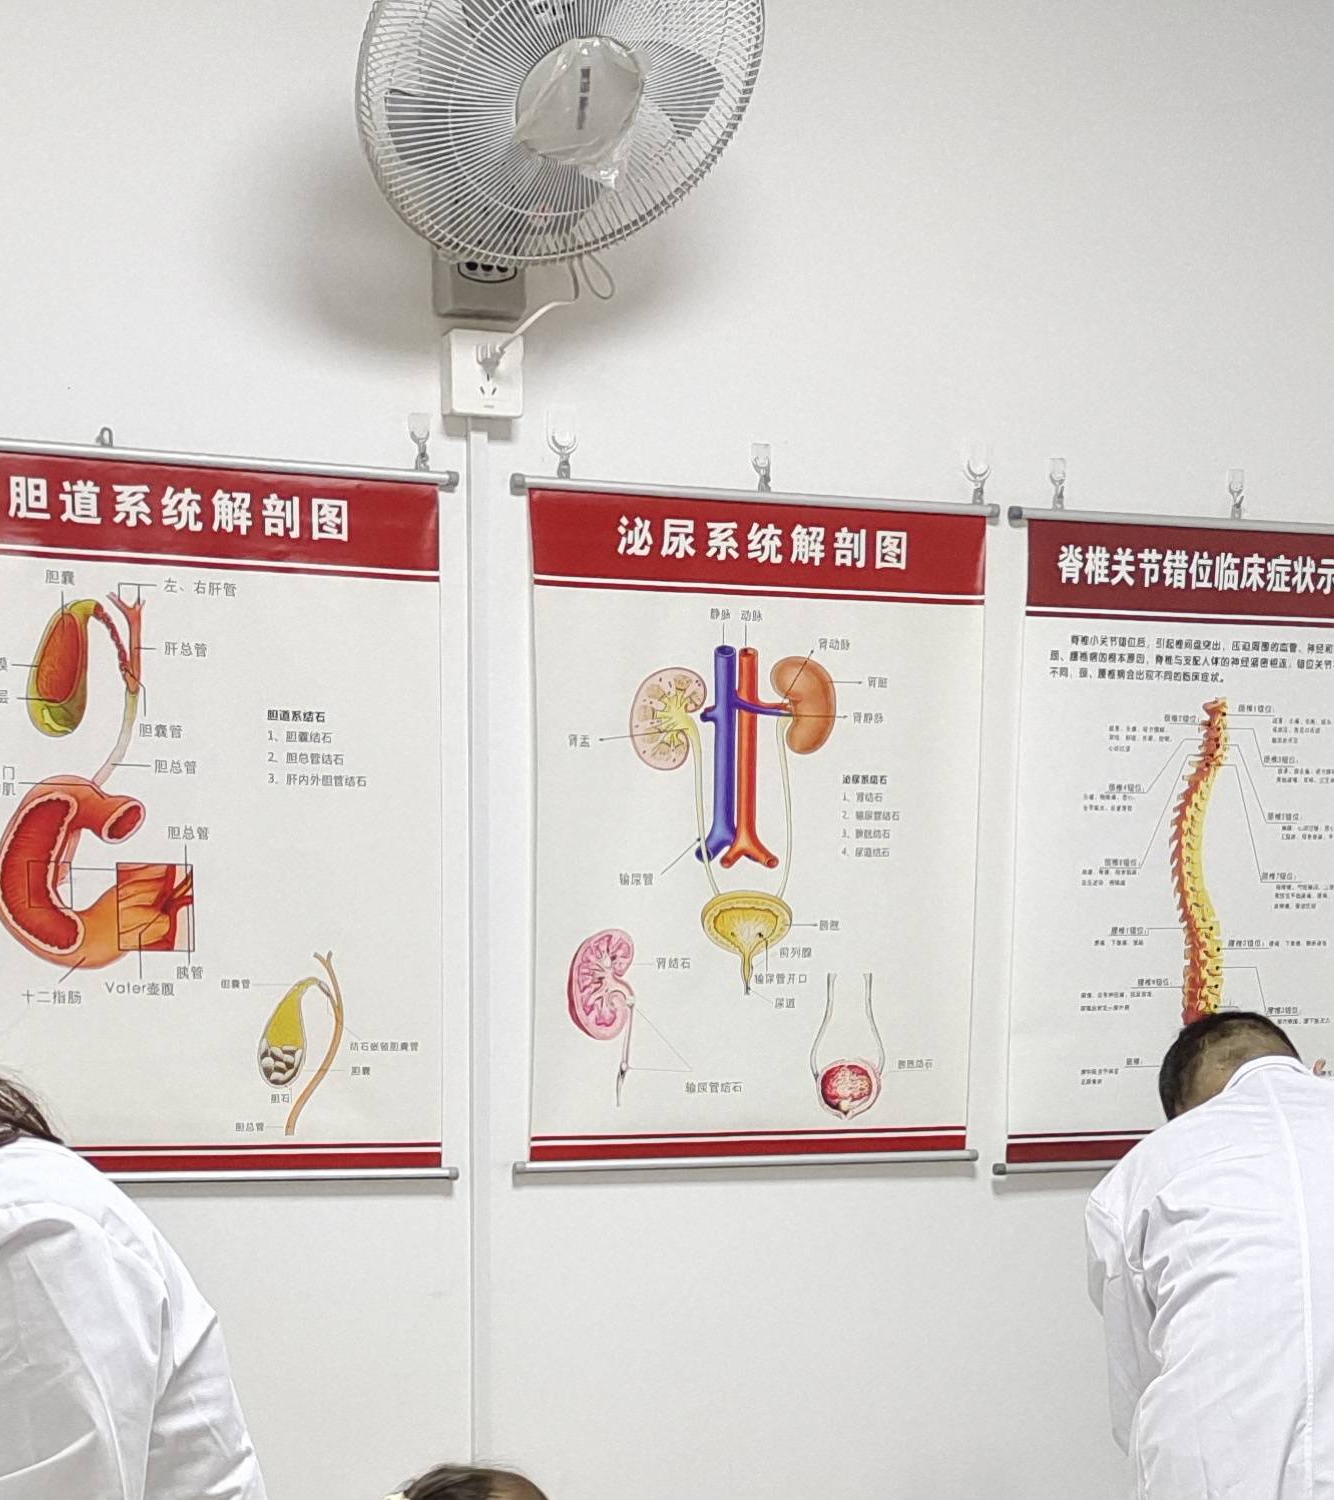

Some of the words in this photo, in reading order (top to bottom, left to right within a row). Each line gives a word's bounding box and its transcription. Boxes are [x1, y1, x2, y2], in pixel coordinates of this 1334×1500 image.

[8, 475, 350, 542] 胆道系统解剖图
[617, 516, 908, 570] 泌尿系统解剖图
[45, 569, 75, 586] 胆囊
[163, 578, 237, 597] 左、右肝管
[164, 642, 208, 658] 肝总管
[139, 723, 183, 738] 胆囊管
[155, 759, 198, 774] 胆总管
[167, 826, 209, 841] 胆总管
[21, 990, 82, 1005] 十二指肠
